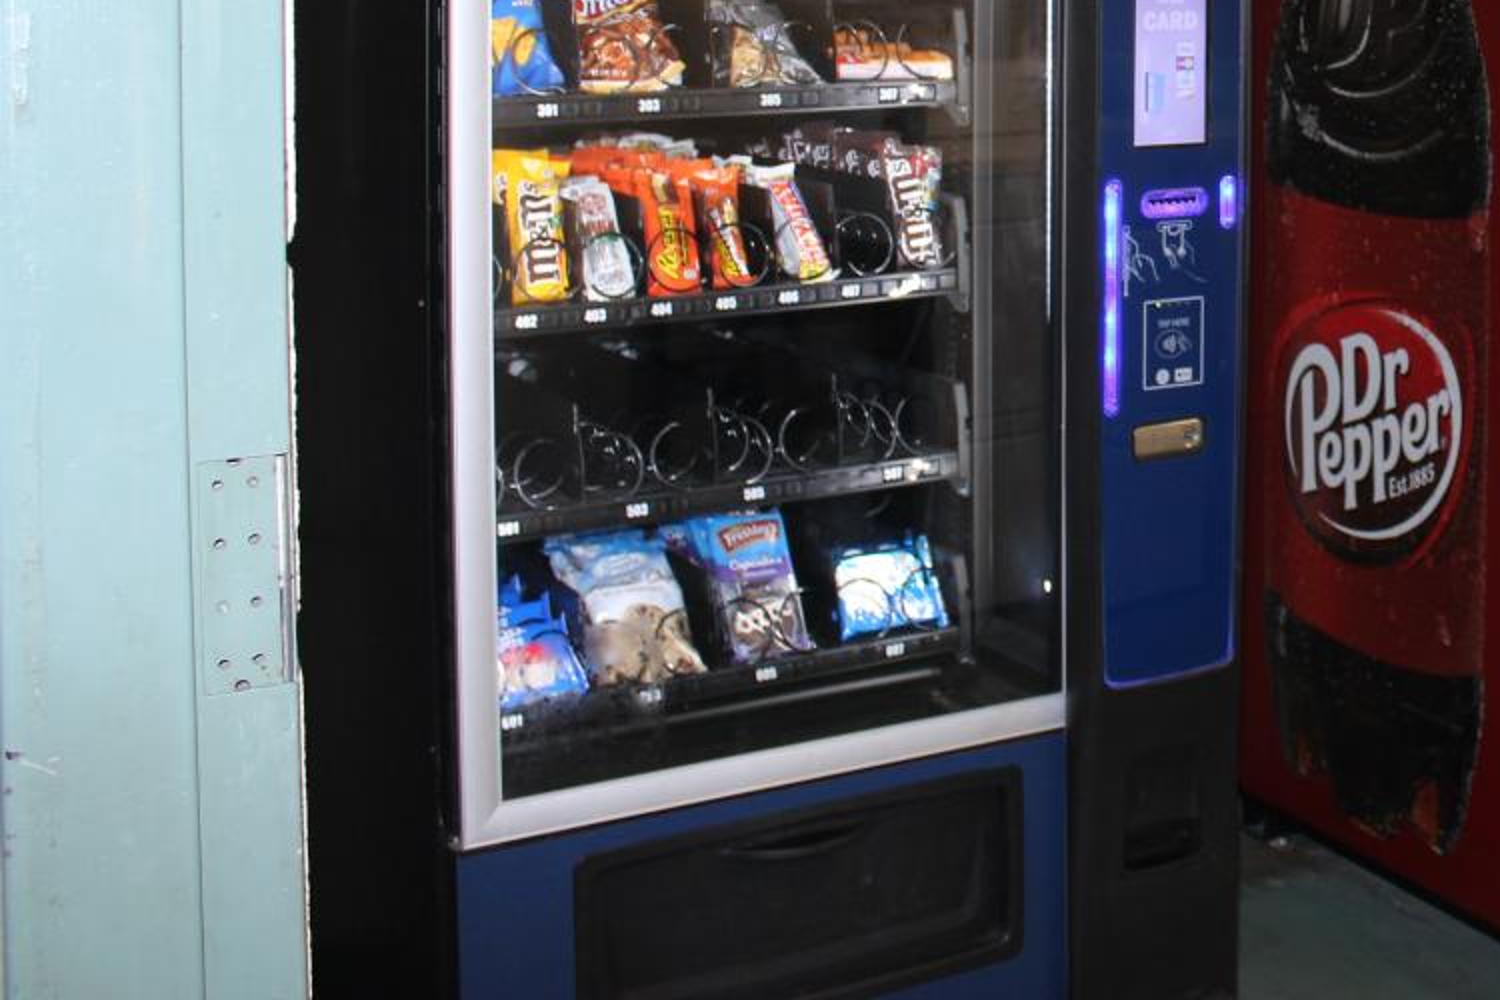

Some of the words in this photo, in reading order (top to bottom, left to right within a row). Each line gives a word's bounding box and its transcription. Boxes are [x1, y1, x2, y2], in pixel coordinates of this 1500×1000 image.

[1144, 10, 1198, 32] CARD
[537, 104, 558, 117] 301
[638, 99, 660, 112] 303
[584, 308, 607, 322] 403
[651, 301, 672, 316] 404
[515, 314, 538, 329] 402
[1340, 332, 1409, 425] Dr
[1286, 342, 1450, 511] Pepper
[626, 503, 648, 519] 503
[498, 521, 520, 537] 501
[501, 714, 523, 731] 601
